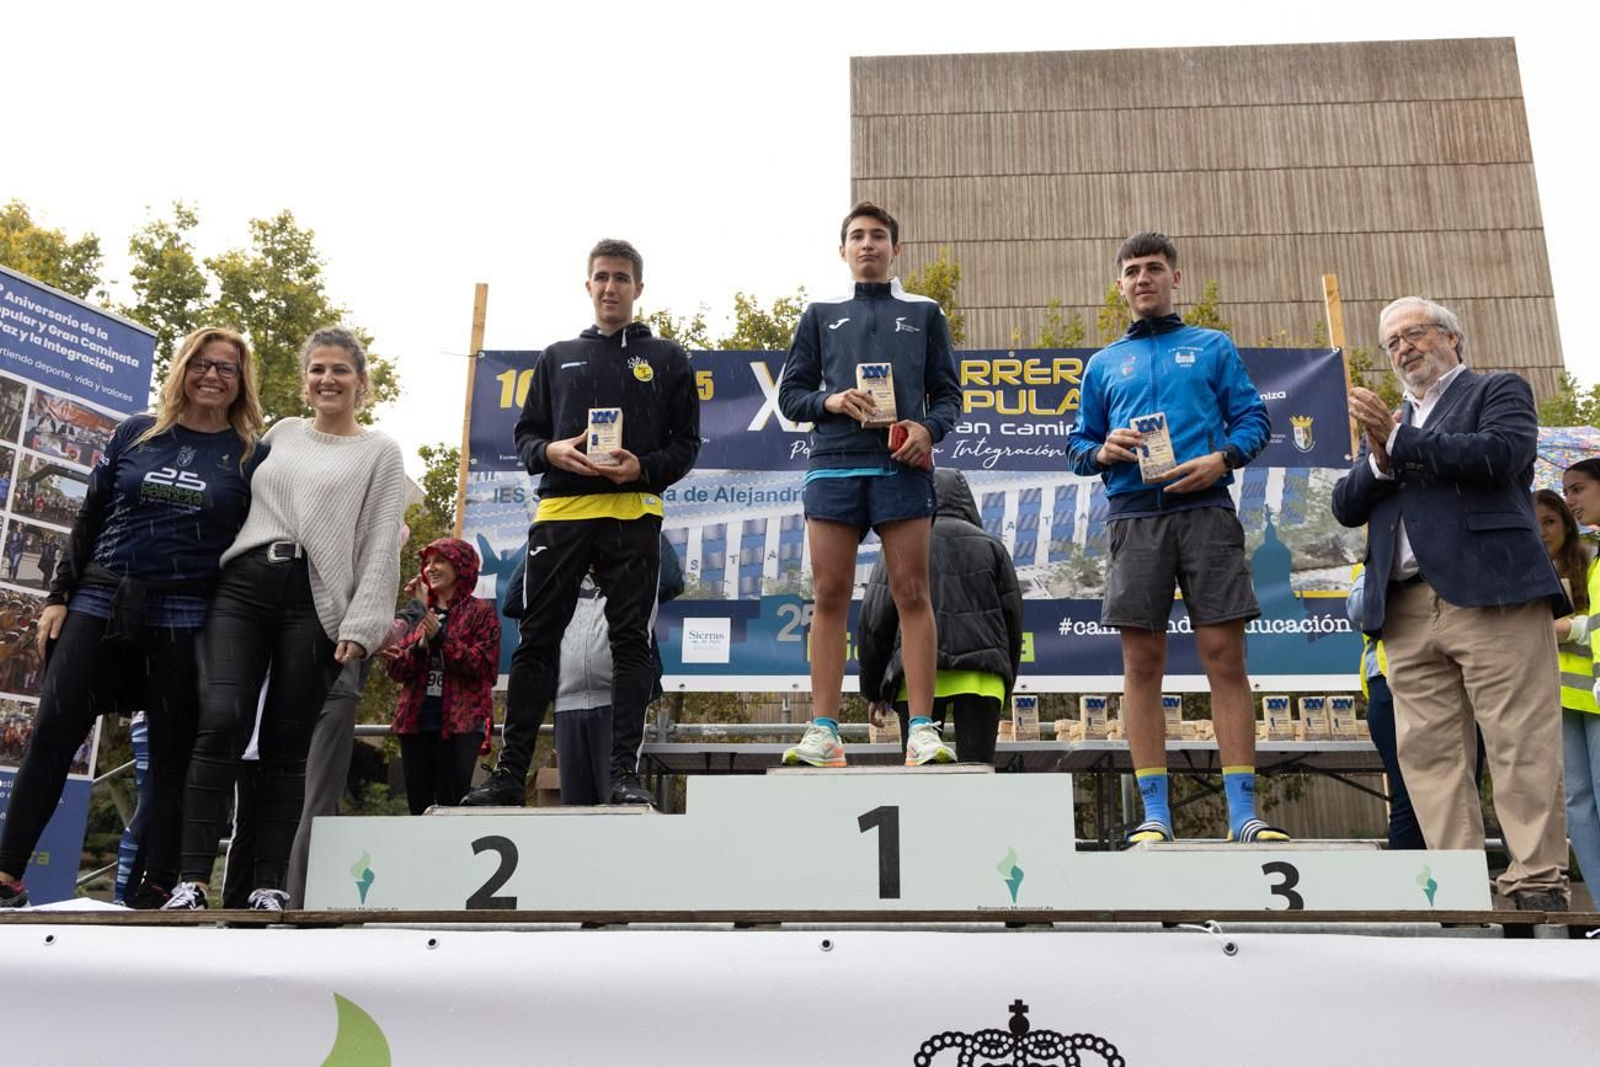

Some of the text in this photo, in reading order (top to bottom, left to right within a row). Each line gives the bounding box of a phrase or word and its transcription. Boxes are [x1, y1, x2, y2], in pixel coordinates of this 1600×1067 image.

[0, 305, 140, 368] pular y Gran Caminata
[5, 291, 109, 340] Aniversario de la
[19, 329, 28, 342] y
[29, 332, 42, 345] la
[43, 337, 114, 373] Integración
[960, 358, 1083, 386] RRER
[0, 347, 34, 365] rtiendo
[74, 375, 94, 387] vida
[95, 383, 101, 392] y
[101, 385, 134, 402] valores
[1259, 391, 1287, 400] niza
[963, 388, 1081, 416] PULA
[143, 467, 207, 492] 25
[493, 487, 526, 504] IES
[683, 485, 709, 503] de
[465, 834, 520, 910] 2
[857, 805, 901, 900] 1
[1260, 860, 1305, 911] 3
